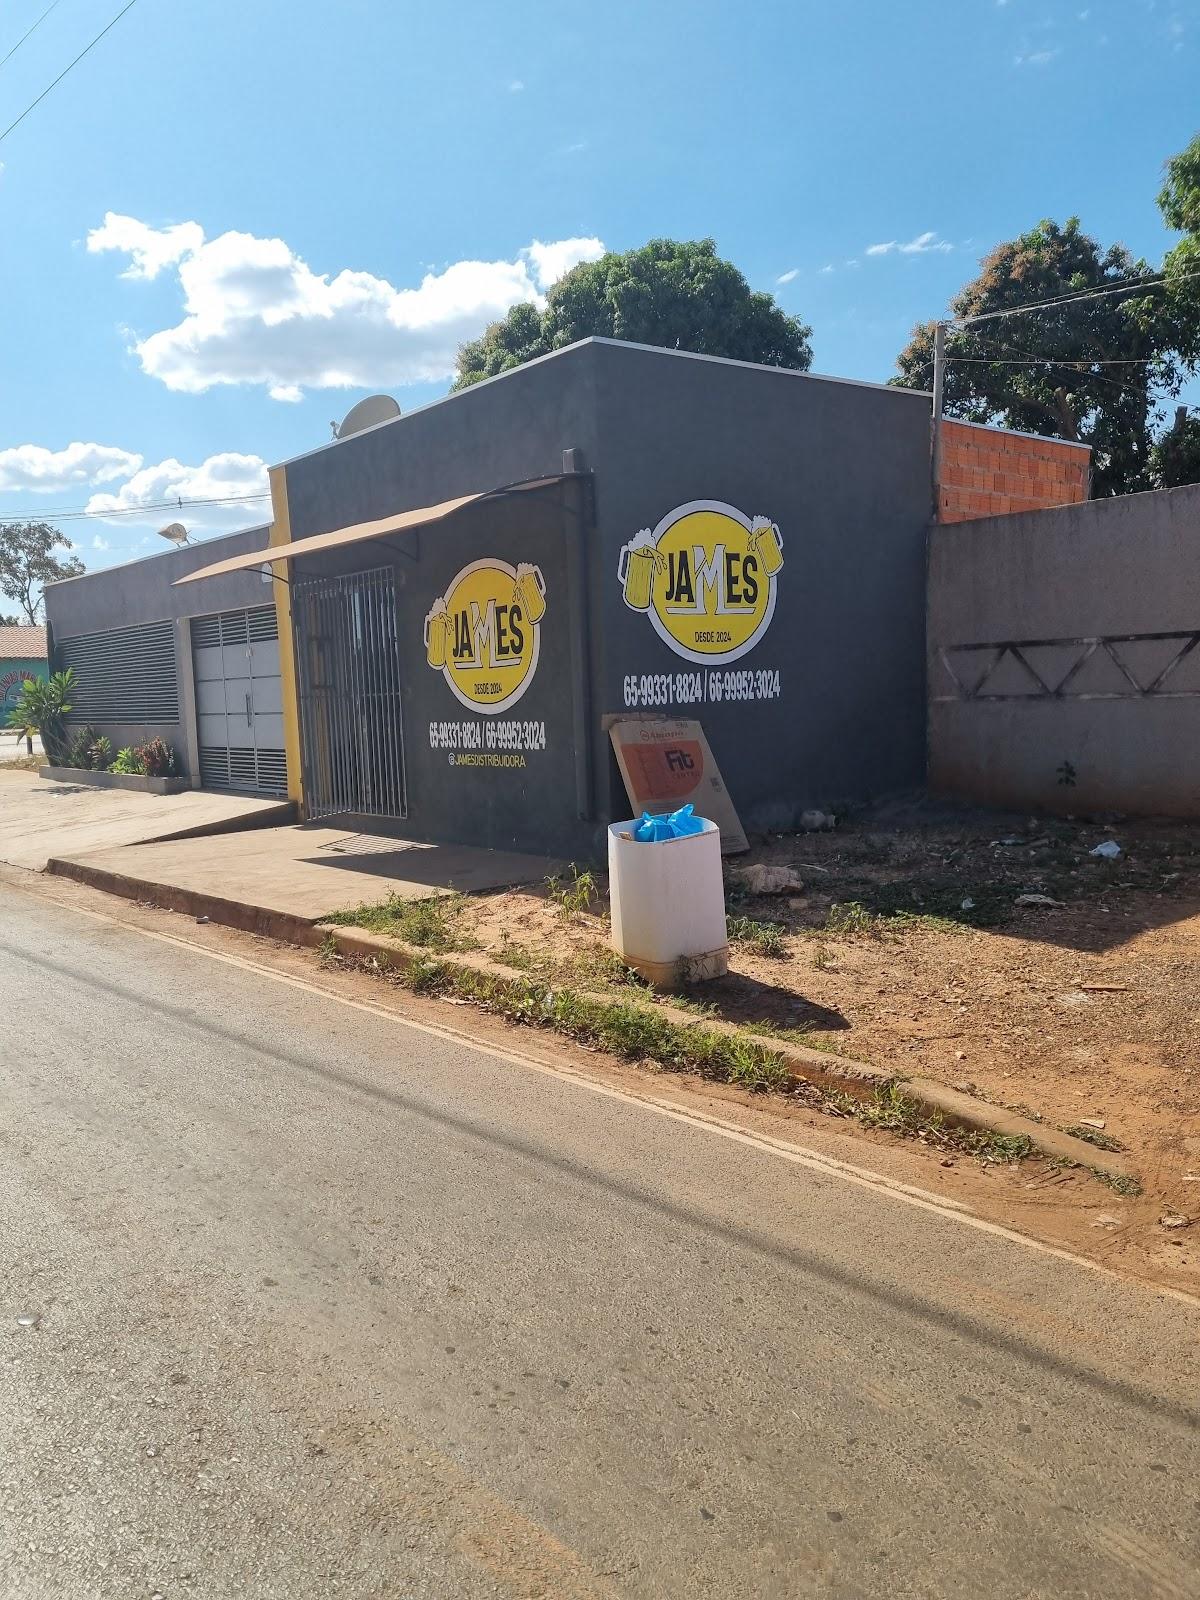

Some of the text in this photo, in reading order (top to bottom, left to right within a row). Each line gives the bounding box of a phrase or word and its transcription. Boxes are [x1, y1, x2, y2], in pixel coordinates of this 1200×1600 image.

[665, 544, 758, 615] JAMES
[453, 599, 523, 669] JAMES
[694, 631, 732, 643] DESDE 2024
[474, 682, 503, 695] DESDE 2024
[448, 752, 526, 768] @JAMESDISTRIBUIDORA
